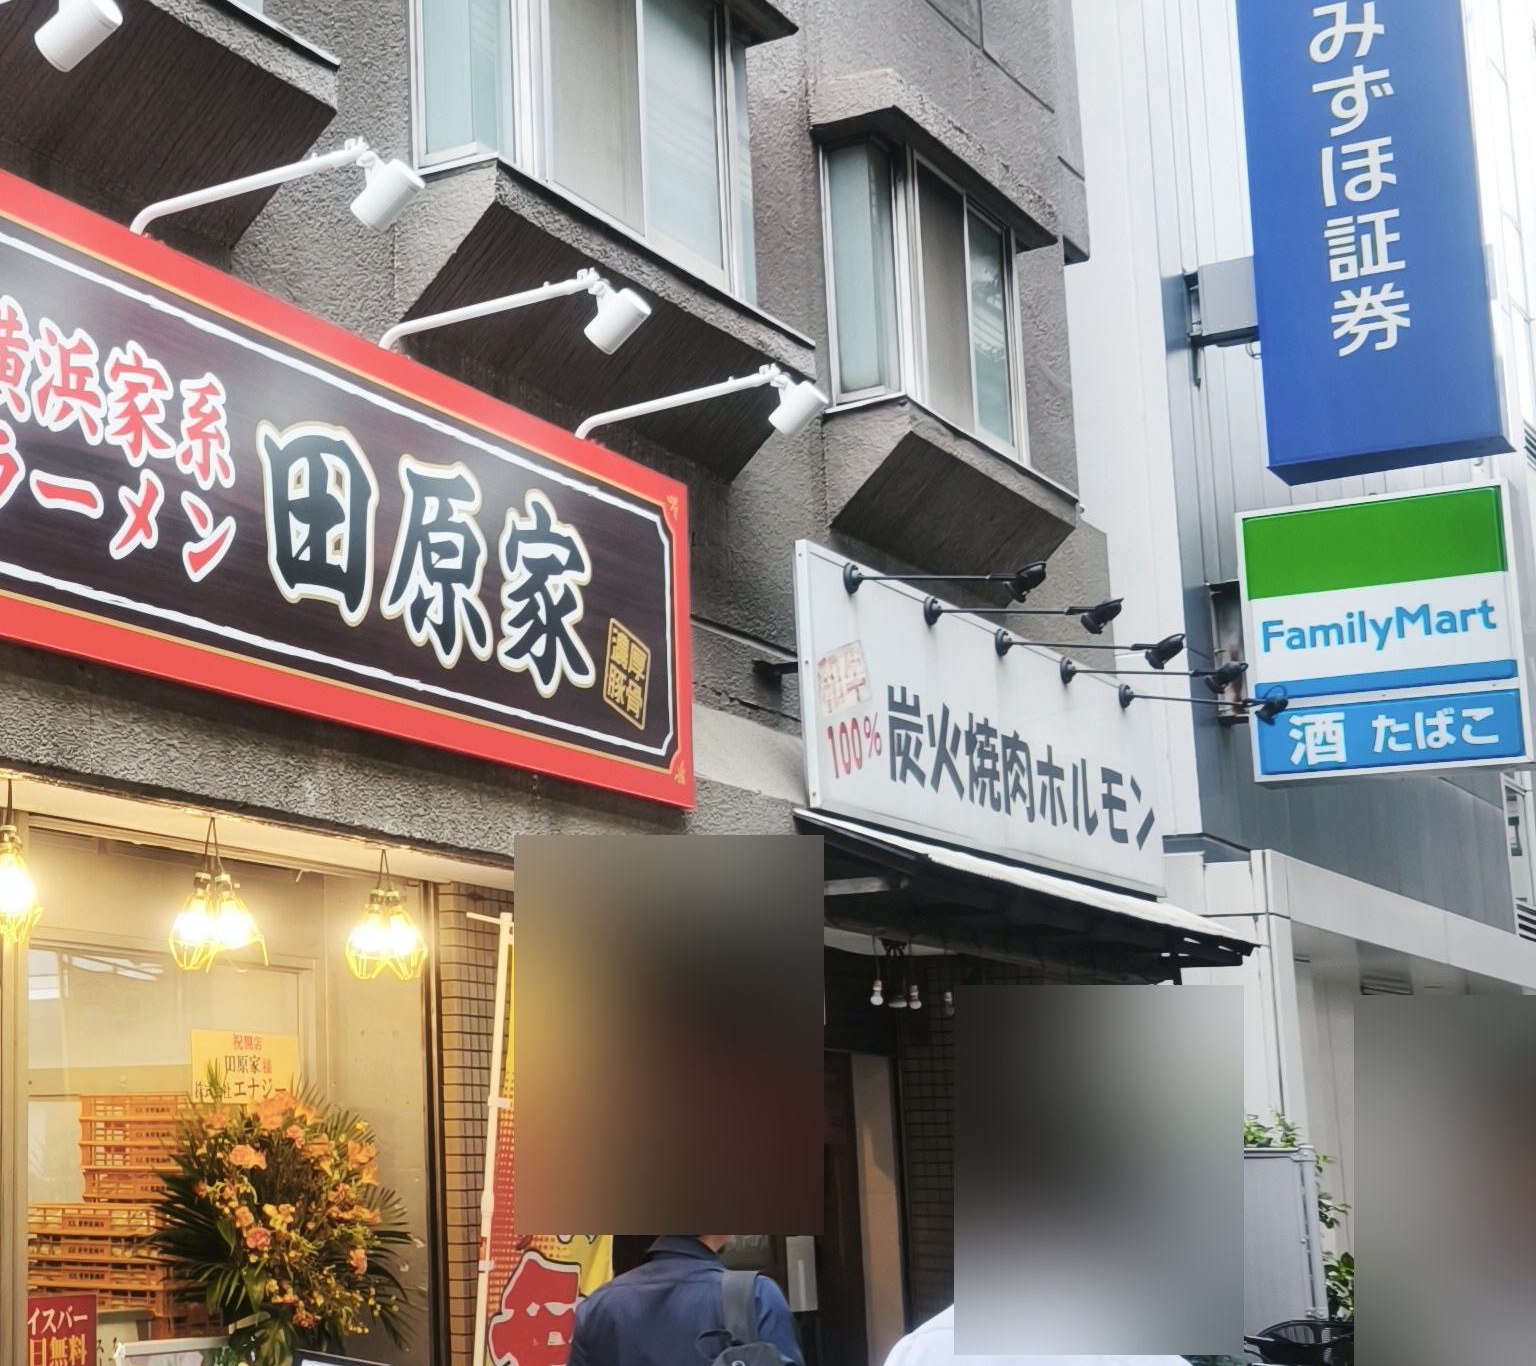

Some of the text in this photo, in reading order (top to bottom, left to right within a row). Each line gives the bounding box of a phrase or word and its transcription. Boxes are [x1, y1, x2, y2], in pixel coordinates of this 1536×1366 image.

[1309, 0, 1410, 357] みずほ証券
[257, 421, 595, 697] 田原家
[1261, 599, 1497, 653] FamilyMart
[827, 712, 882, 779] 100%
[1288, 707, 1499, 765] 酒 たばこ
